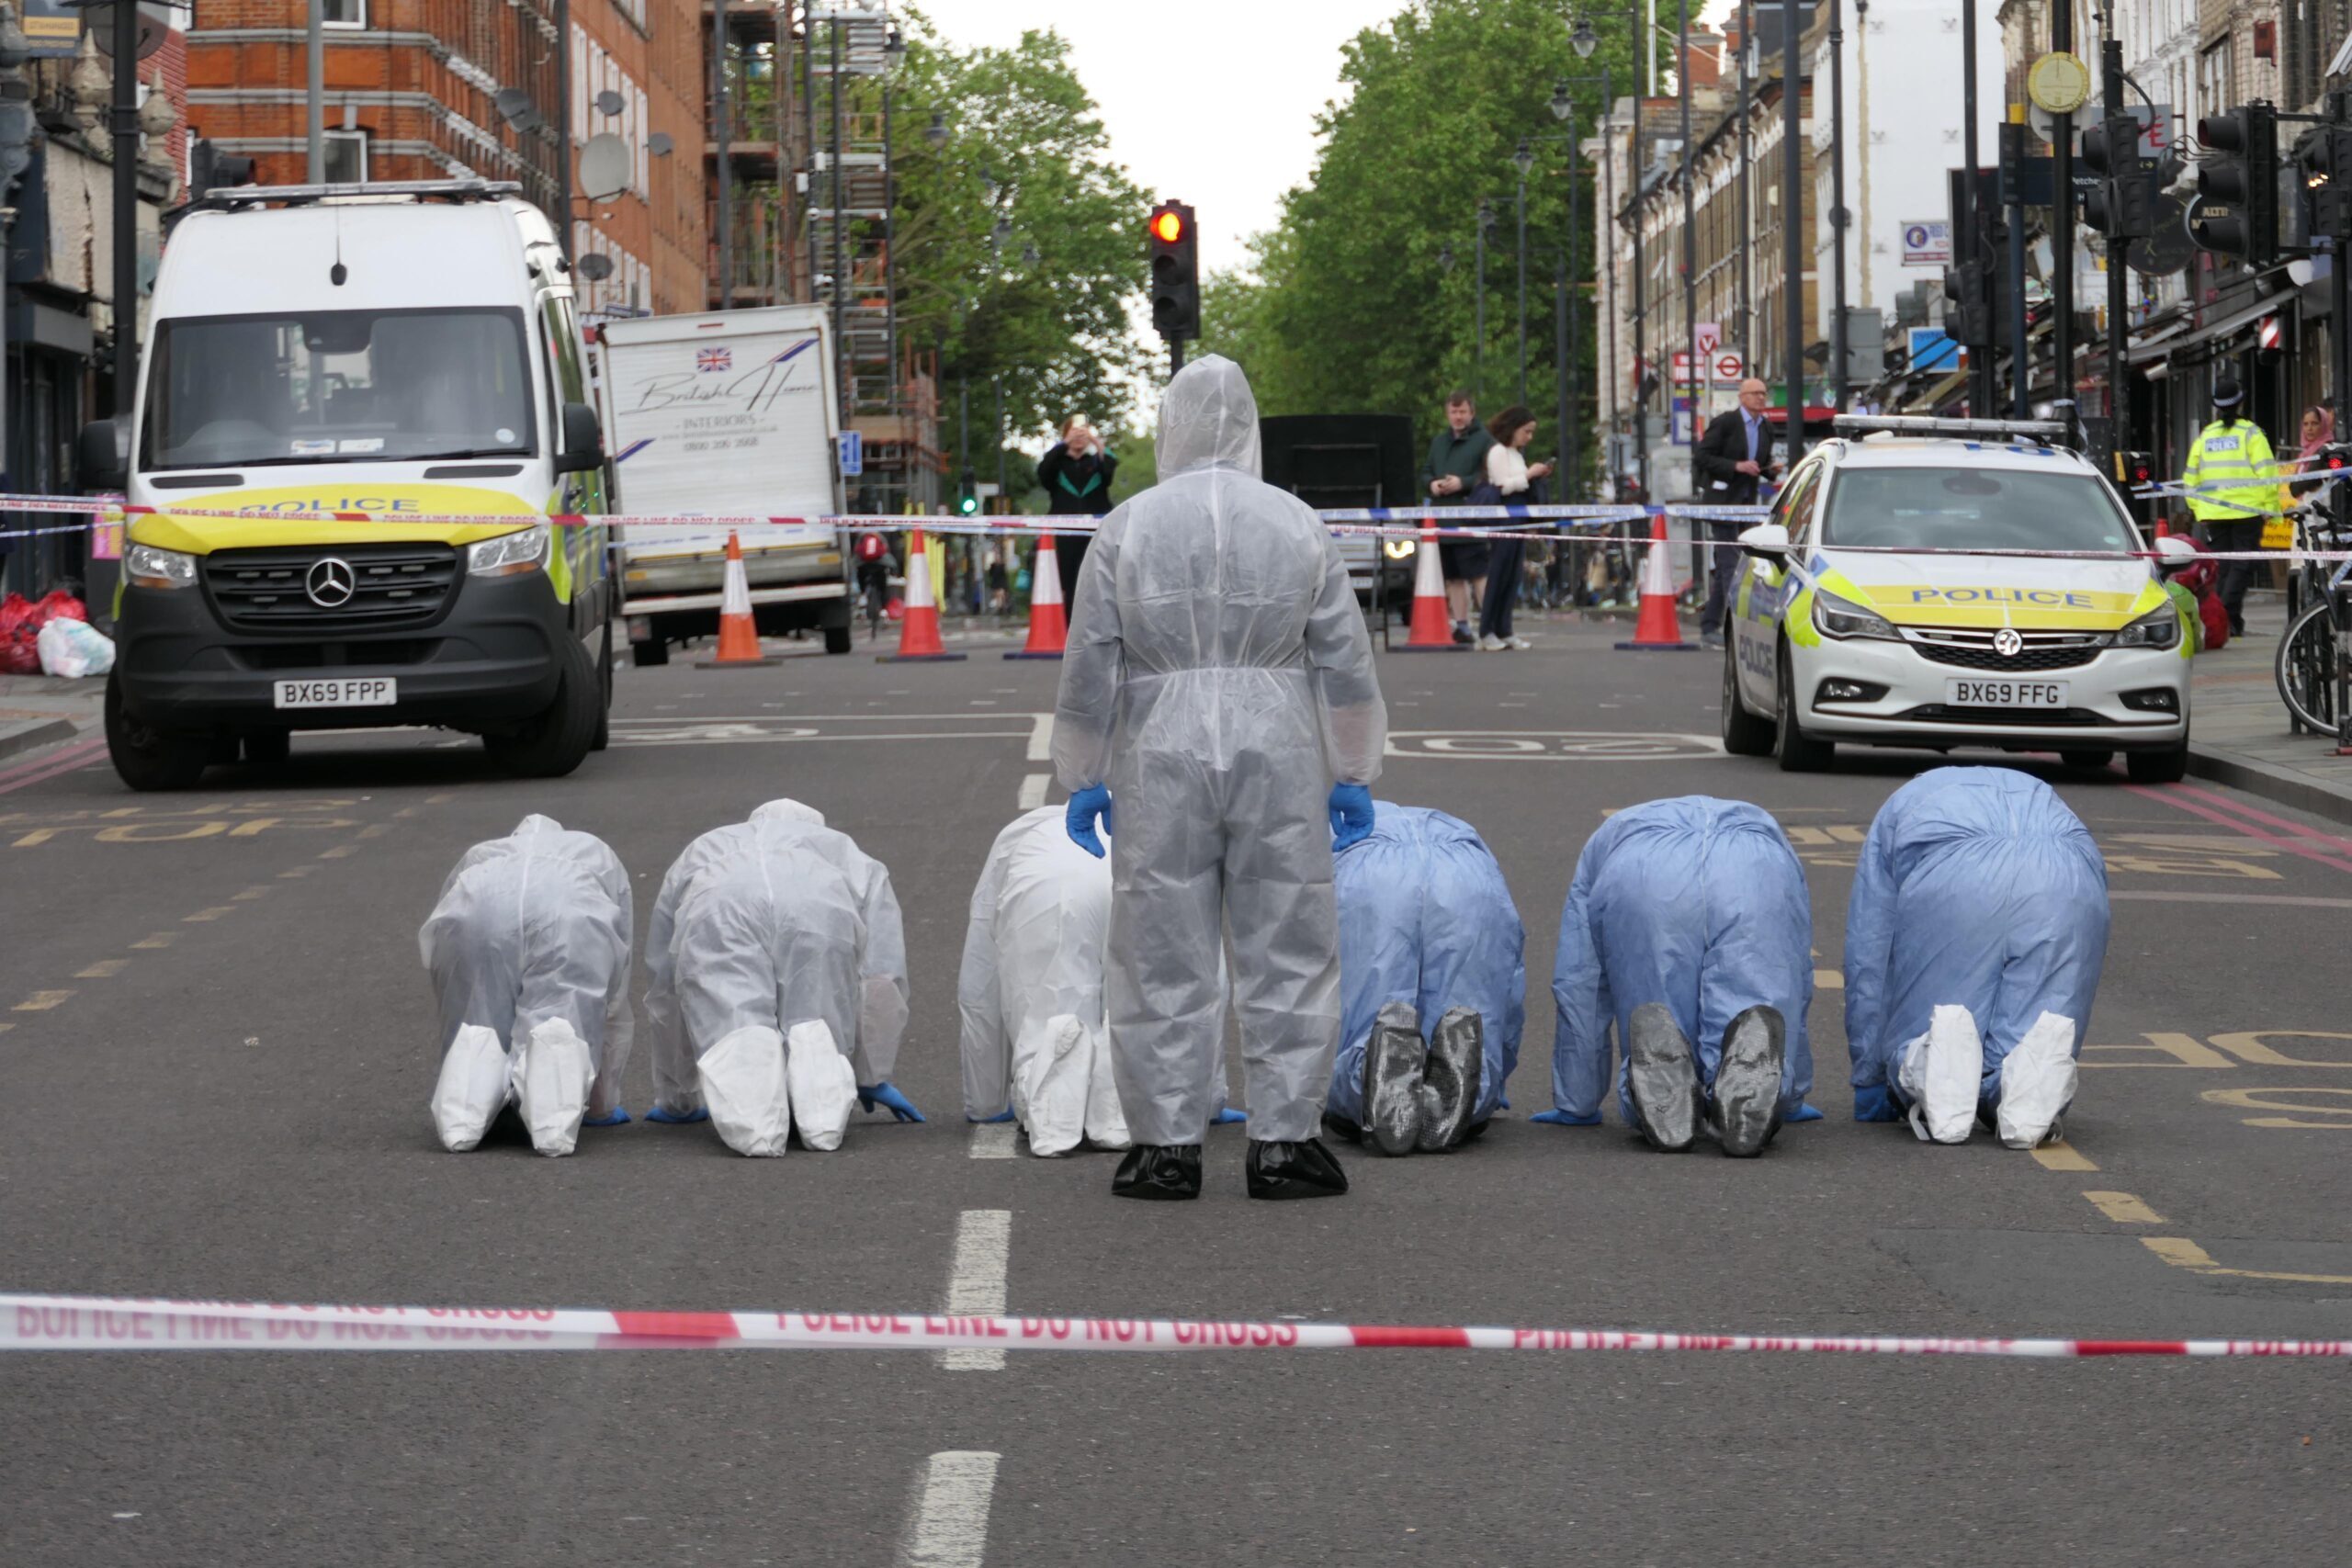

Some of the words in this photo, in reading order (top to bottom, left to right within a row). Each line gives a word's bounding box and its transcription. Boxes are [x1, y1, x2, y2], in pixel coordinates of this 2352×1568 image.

[1912, 588, 2093, 608] POLICE
[1738, 634, 1773, 677] POLICE
[284, 682, 339, 703] BX69
[345, 682, 386, 700] FPP
[1957, 682, 2012, 702] BX69
[2018, 684, 2059, 705] FFG
[1021, 1319, 1071, 1340] DO
[1085, 1320, 1155, 1342] NOT
